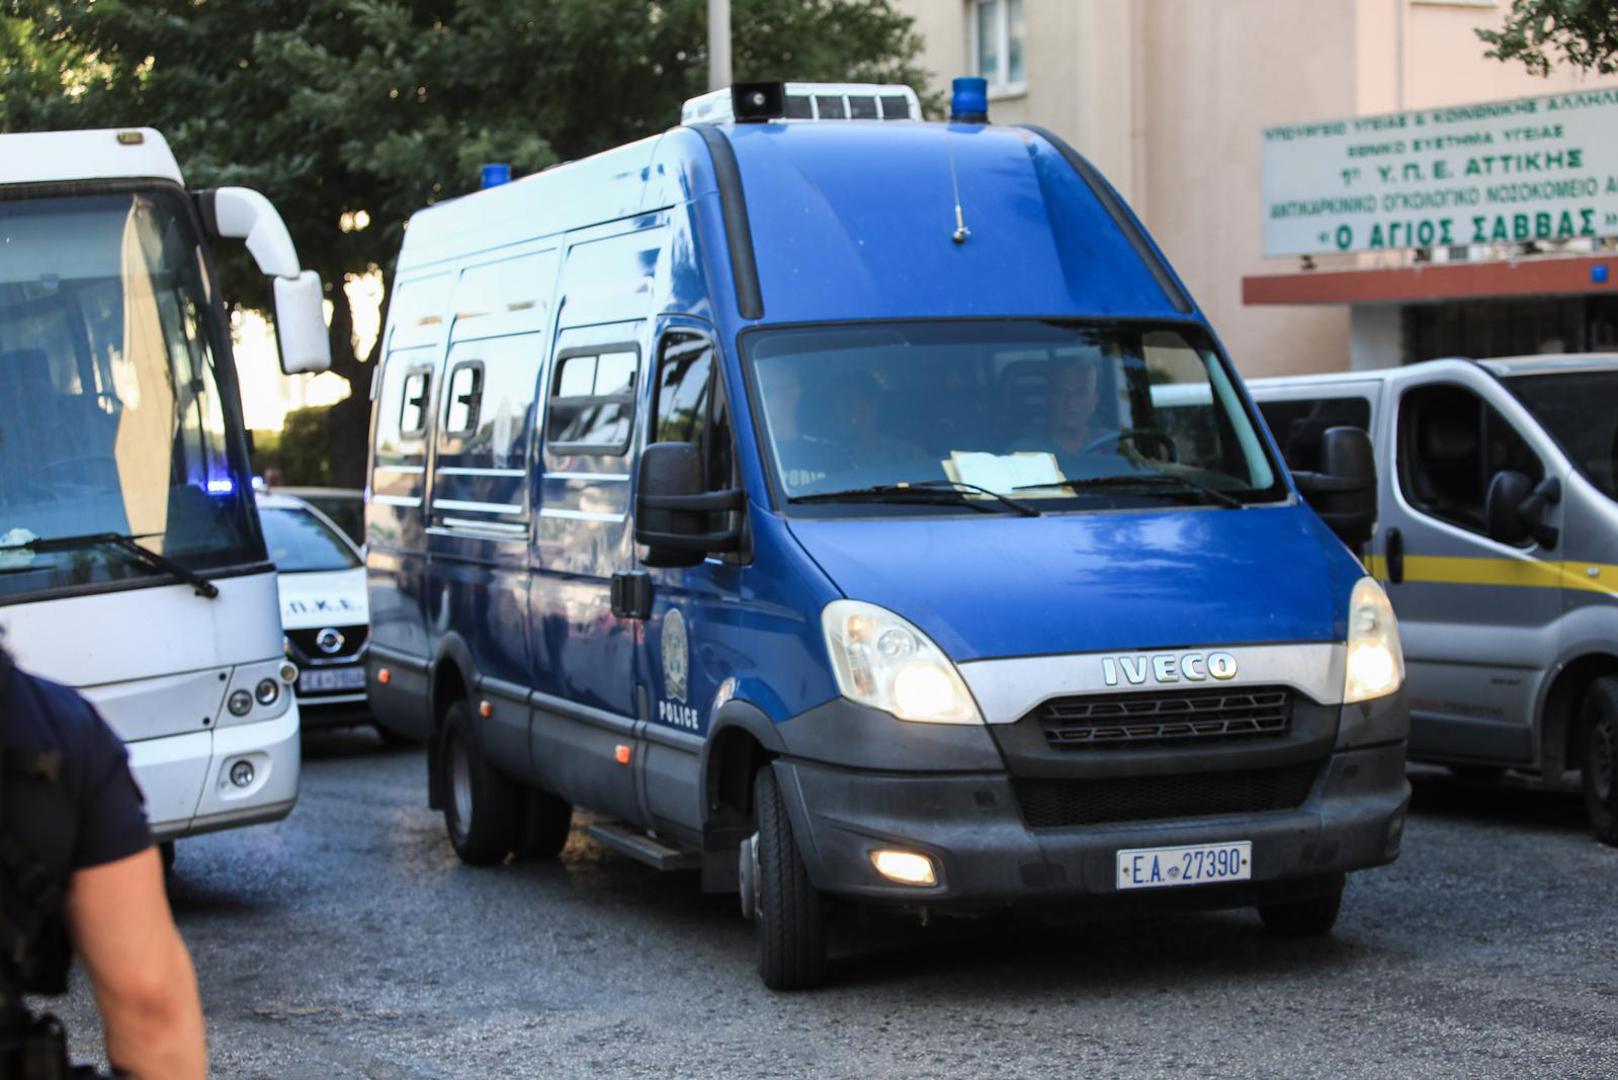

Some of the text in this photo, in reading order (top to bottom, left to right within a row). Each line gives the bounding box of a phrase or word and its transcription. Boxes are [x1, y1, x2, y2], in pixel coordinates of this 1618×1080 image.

[1547, 90, 1618, 111] ΑΛΛΗΛ
[1503, 123, 1564, 142] ΥΓΕΙΑΣ
[1464, 148, 1583, 176] ΑΤΤΙΚΗΣ
[1487, 175, 1599, 204] ΝΟΣΟΚΟΜΕΙΟ
[1369, 217, 1454, 249] ΑΓΙΟΣ
[1102, 651, 1238, 686] IVECO
[659, 700, 699, 730] POLICE
[1182, 848, 1241, 882] 27390
